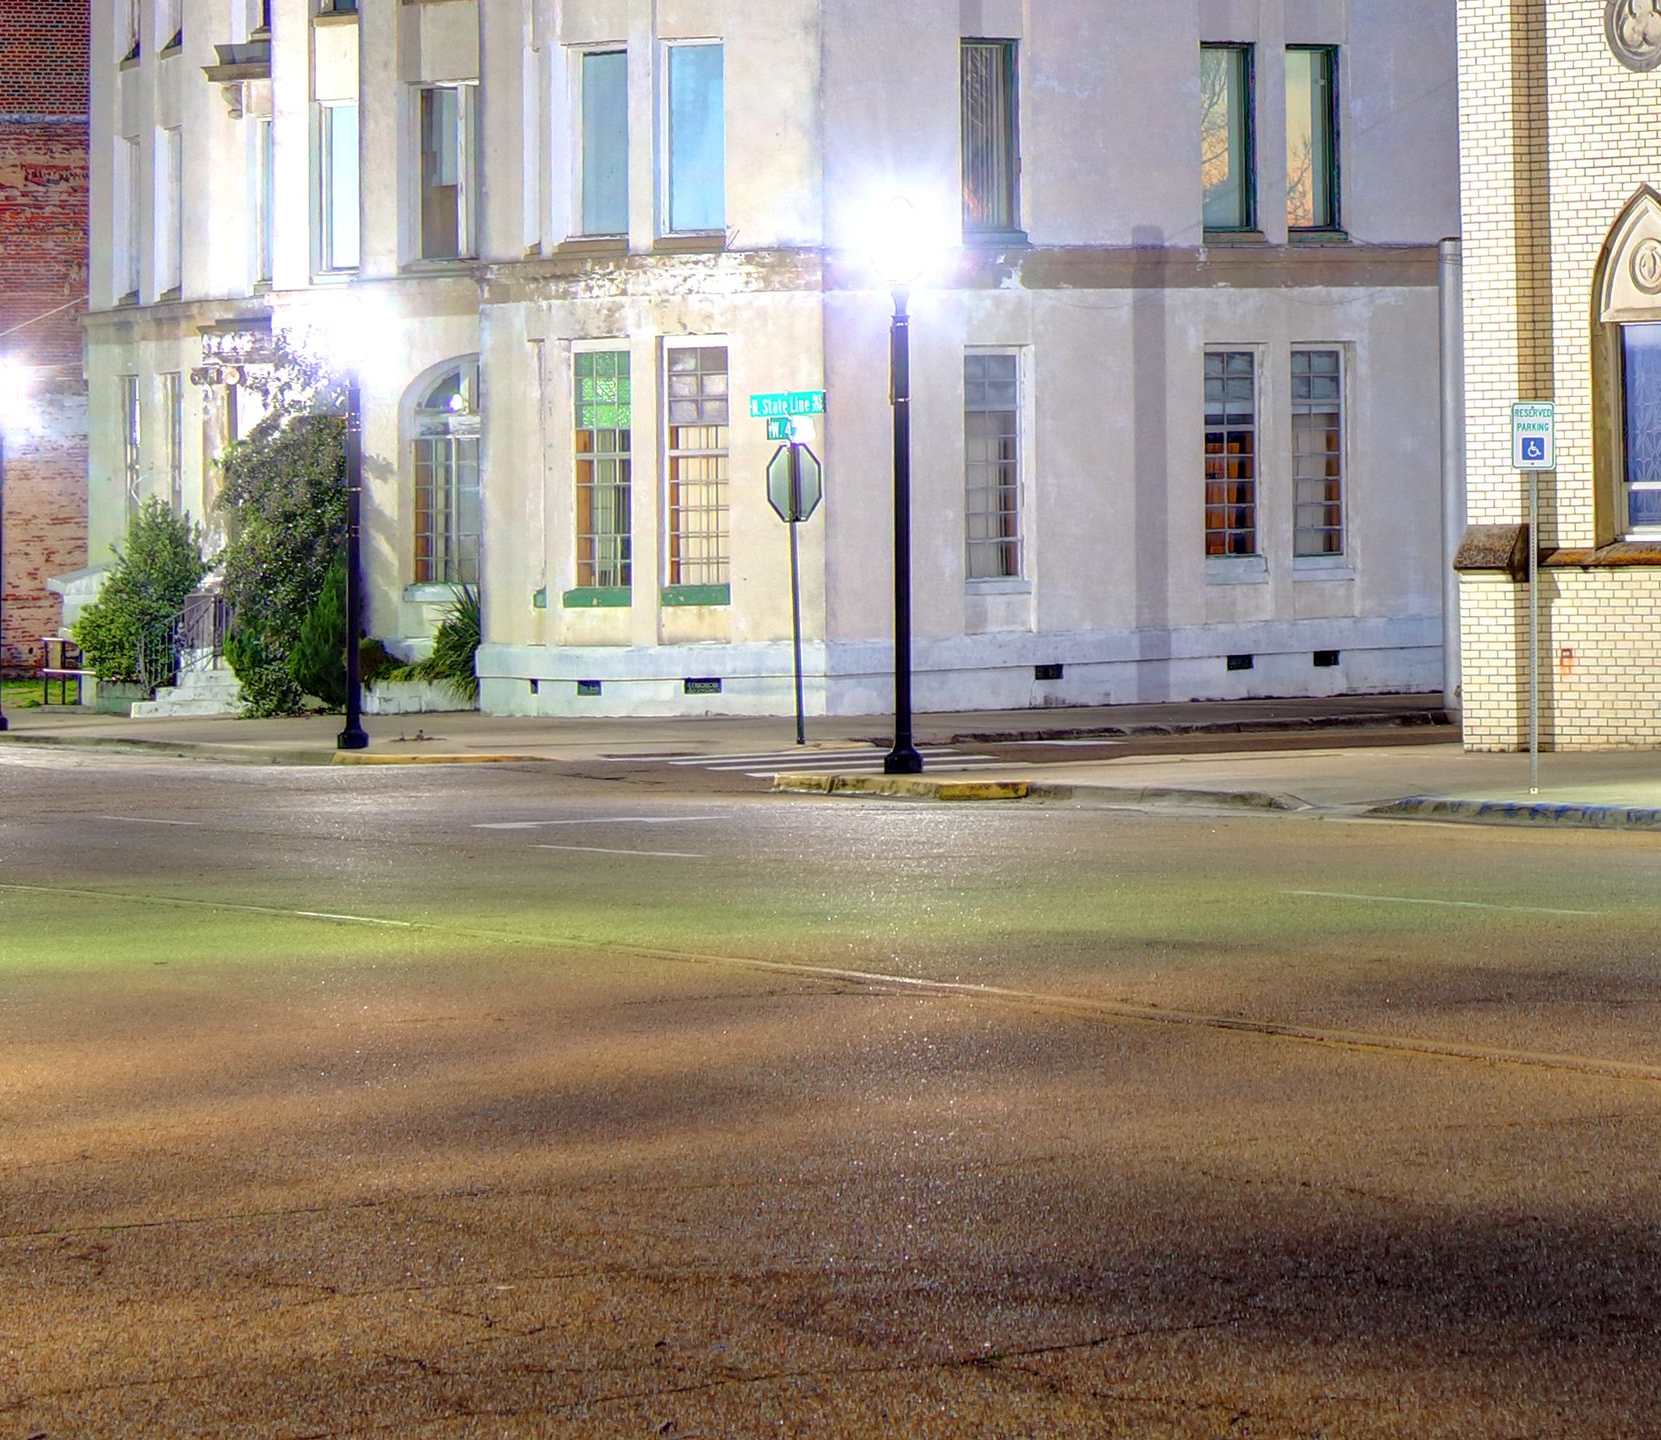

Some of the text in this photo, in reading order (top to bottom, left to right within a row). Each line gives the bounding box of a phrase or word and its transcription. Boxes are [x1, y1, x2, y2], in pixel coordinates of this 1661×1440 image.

[762, 398, 788, 414] State
[790, 396, 810, 413] Line
[1515, 409, 1552, 418] RESERVED
[1517, 423, 1549, 431] PARKING
